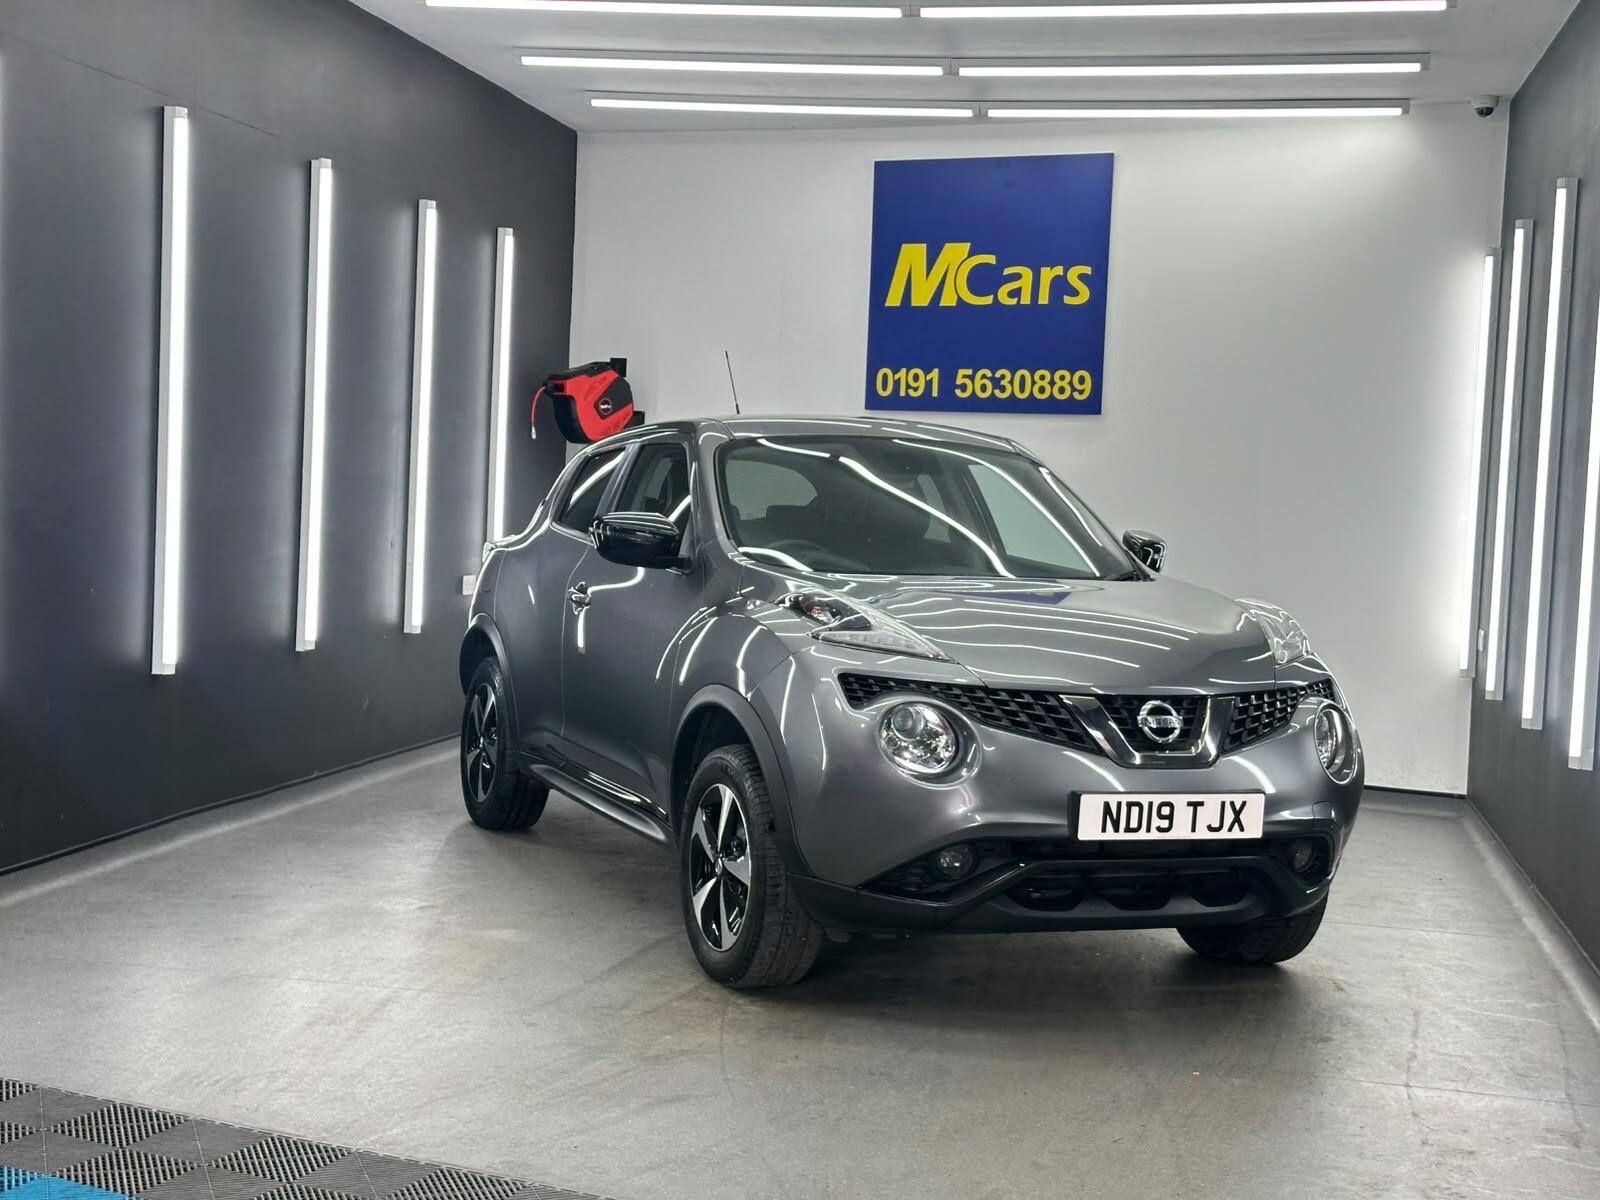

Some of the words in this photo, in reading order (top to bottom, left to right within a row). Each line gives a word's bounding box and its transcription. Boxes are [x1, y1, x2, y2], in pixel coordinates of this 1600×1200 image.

[885, 243, 1092, 306] MCars
[876, 368, 939, 397] 0191
[955, 369, 1092, 400] 5630889
[1101, 801, 1175, 833] ND19
[1187, 801, 1247, 833] TJX
